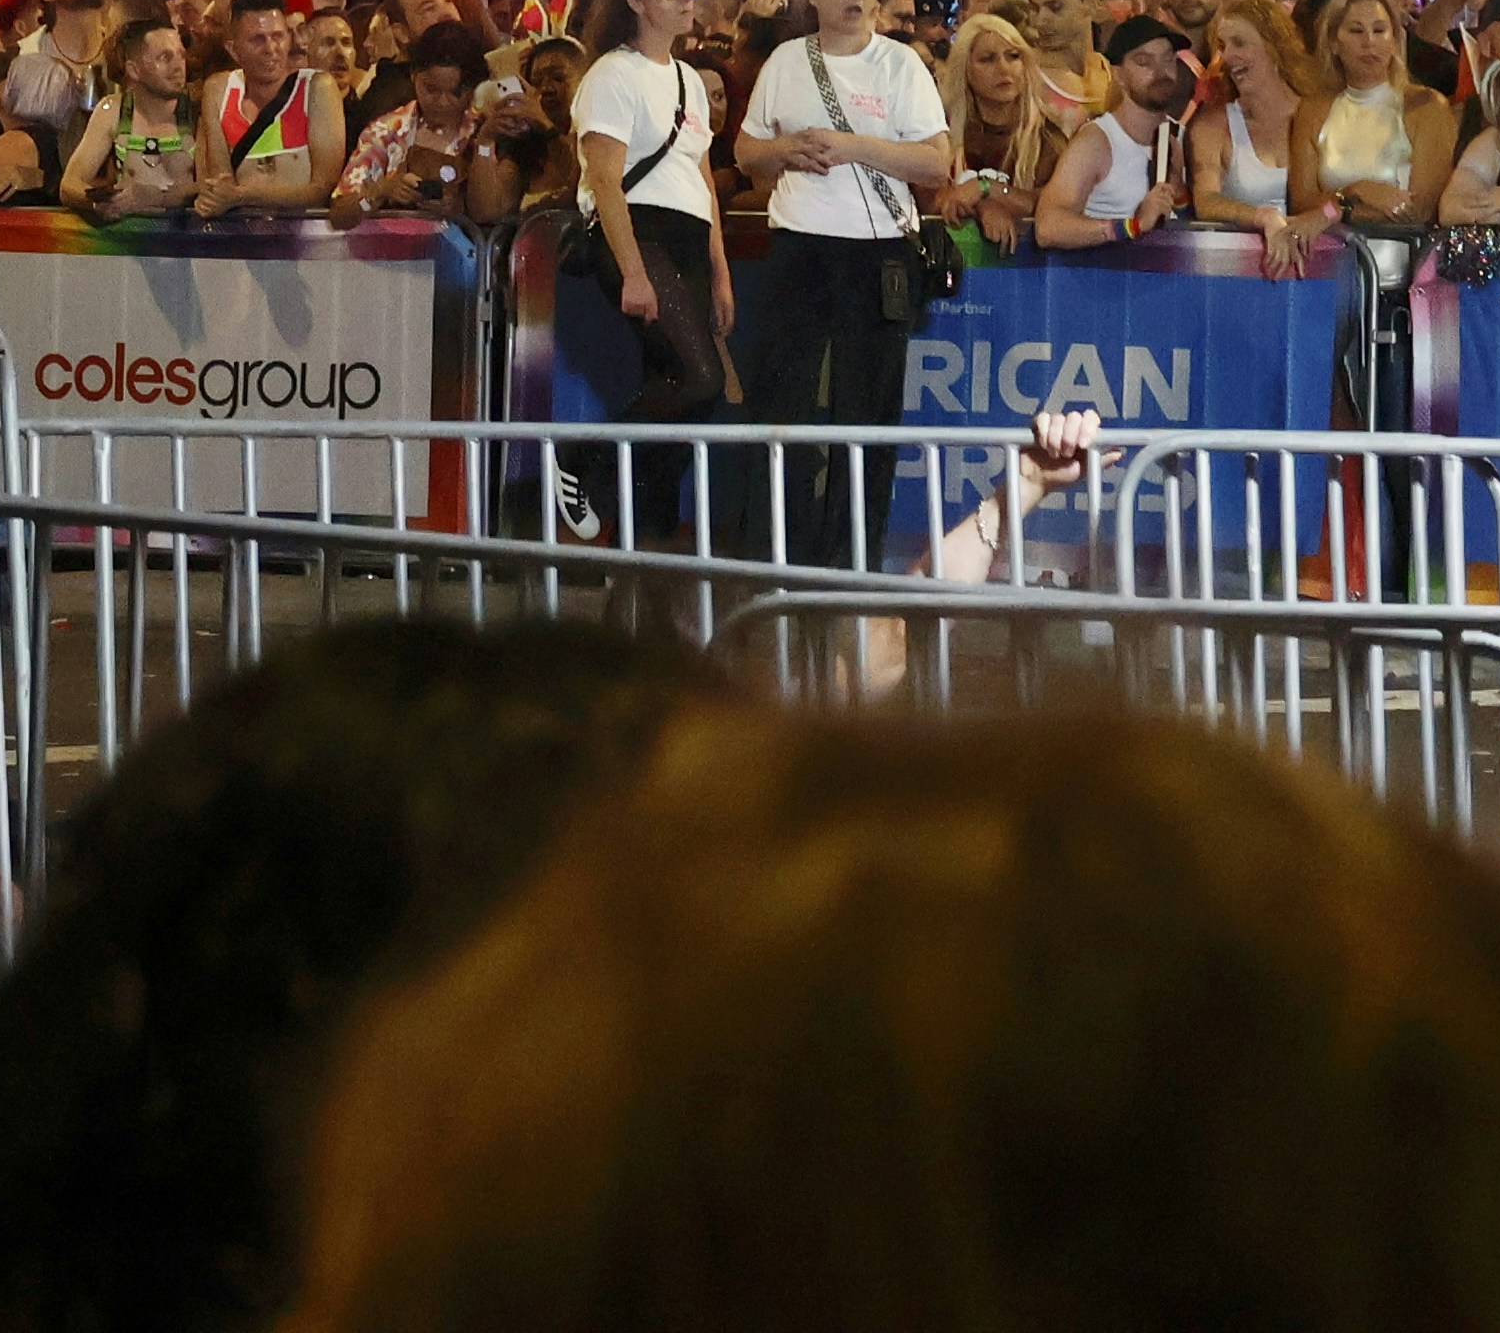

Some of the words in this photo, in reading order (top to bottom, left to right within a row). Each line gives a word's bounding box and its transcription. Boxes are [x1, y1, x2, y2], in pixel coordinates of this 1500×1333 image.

[939, 301, 993, 316] Partner
[35, 342, 382, 420] colesgroup
[903, 339, 1191, 421] RICAN
